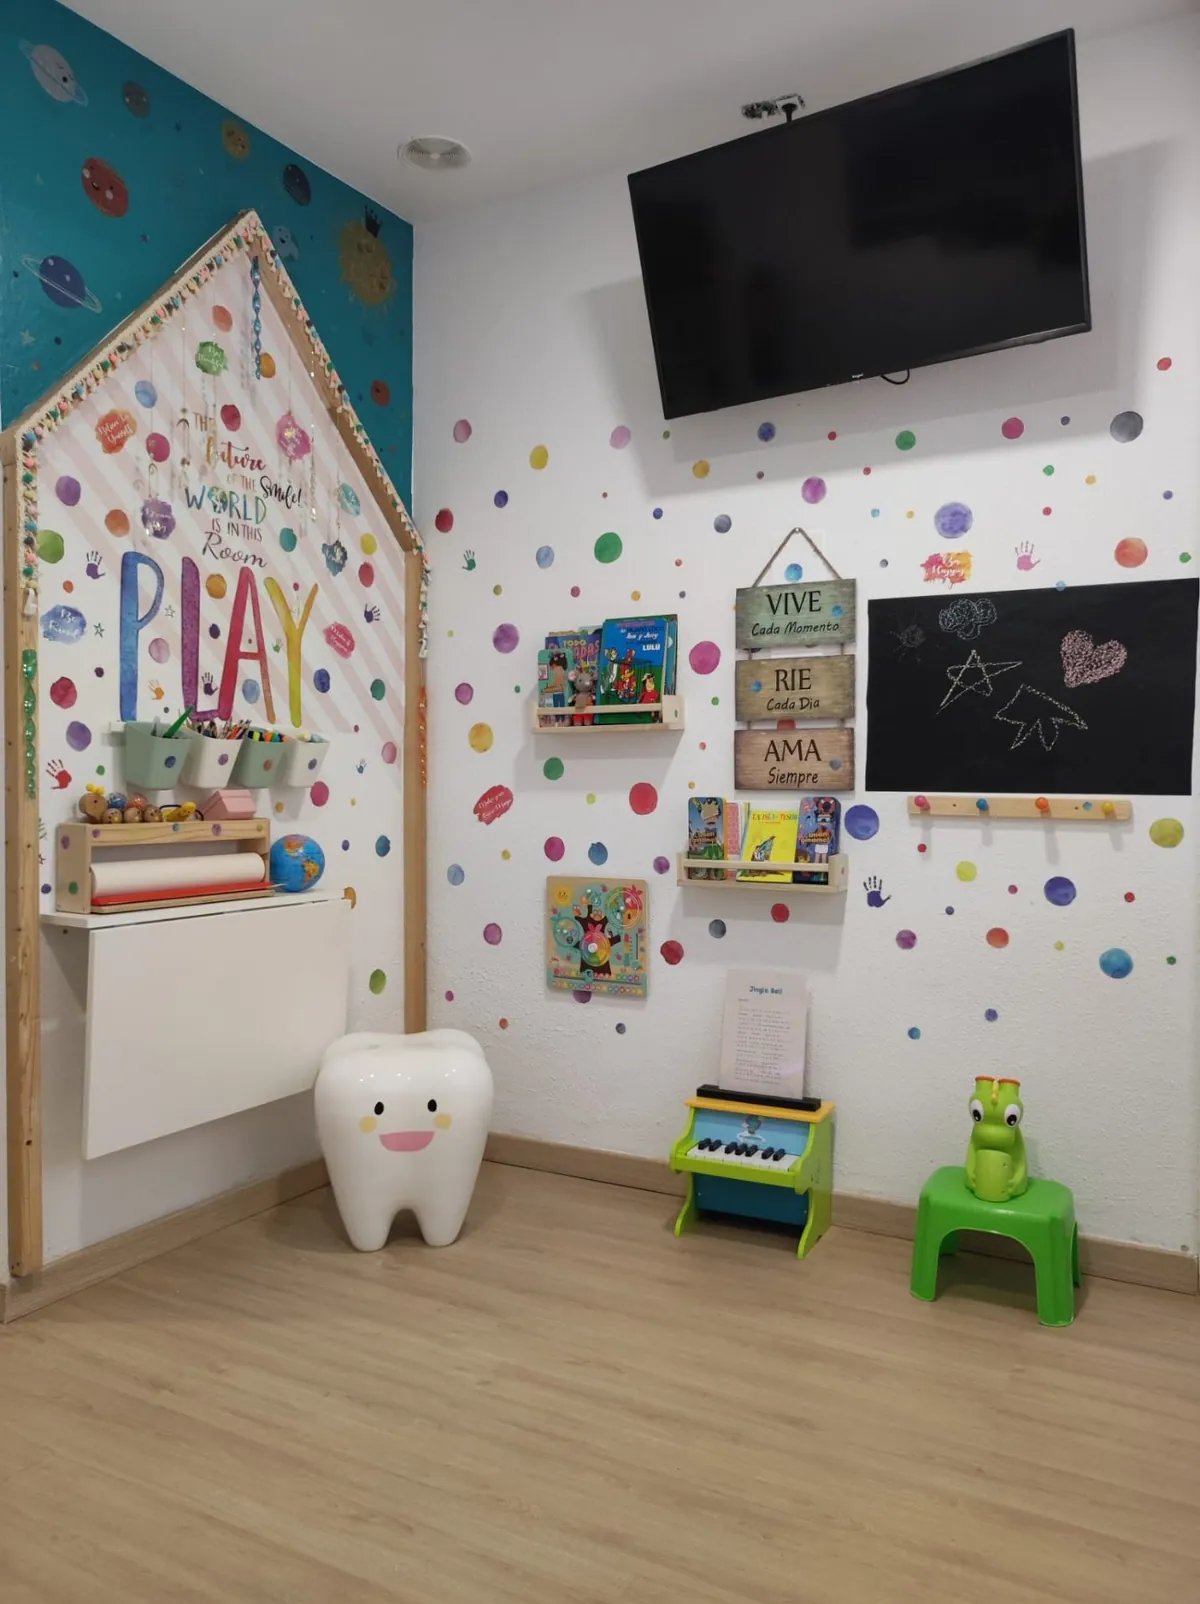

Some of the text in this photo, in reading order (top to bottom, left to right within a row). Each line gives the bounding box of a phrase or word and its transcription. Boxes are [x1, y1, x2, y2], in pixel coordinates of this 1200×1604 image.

[241, 475, 257, 491] THE
[212, 518, 263, 542] IS IN THIS
[202, 531, 268, 568] Room
[766, 590, 822, 615] VIVE
[119, 551, 319, 728] PLAY
[751, 620, 840, 637] Cada Momento
[774, 667, 812, 692] RIE
[766, 698, 796, 711] Cada
[764, 739, 822, 762] AMA
[767, 766, 819, 788] Siempre
[749, 985, 769, 995] Jingle
